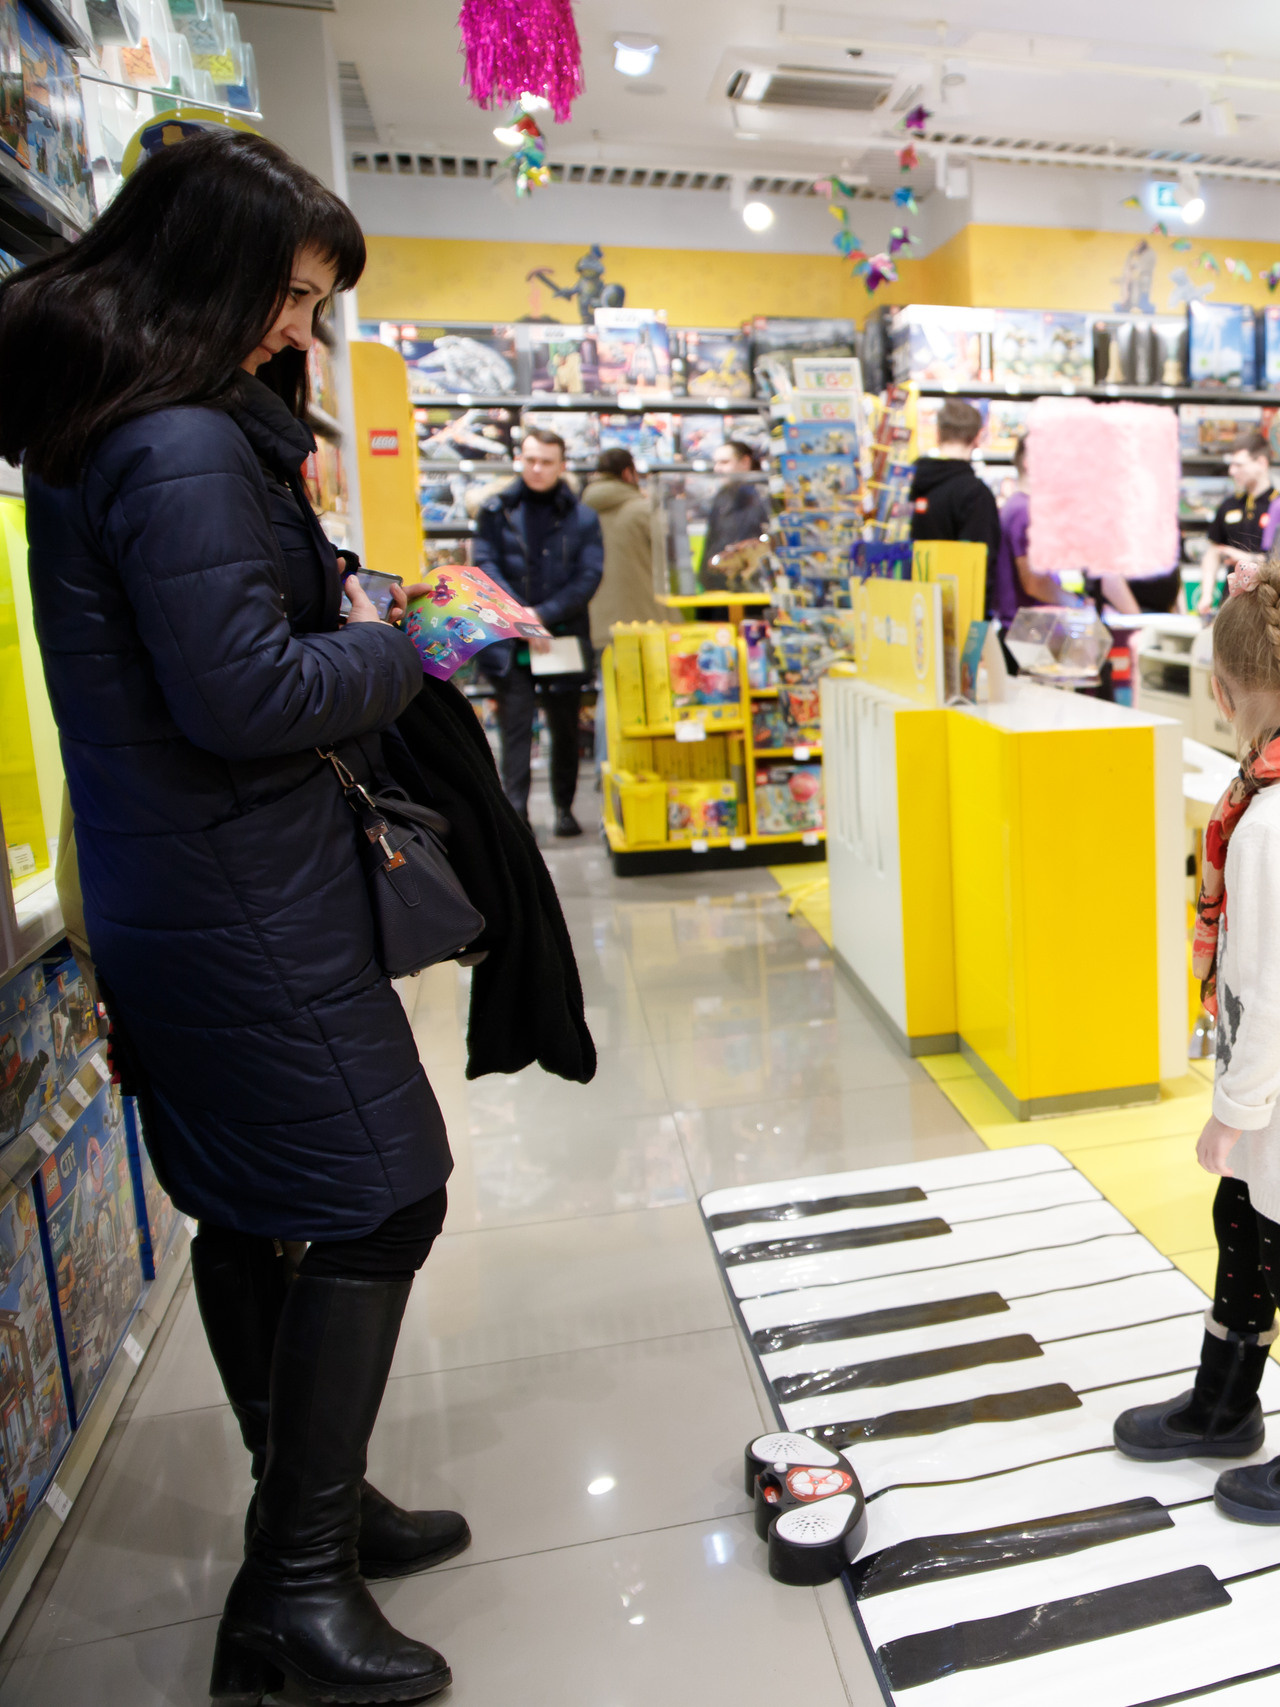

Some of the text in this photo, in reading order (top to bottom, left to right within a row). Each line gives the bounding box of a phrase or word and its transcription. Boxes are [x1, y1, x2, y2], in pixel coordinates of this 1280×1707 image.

[371, 436, 397, 450] LEGO
[46, 1141, 77, 1195] LEGO CITY
